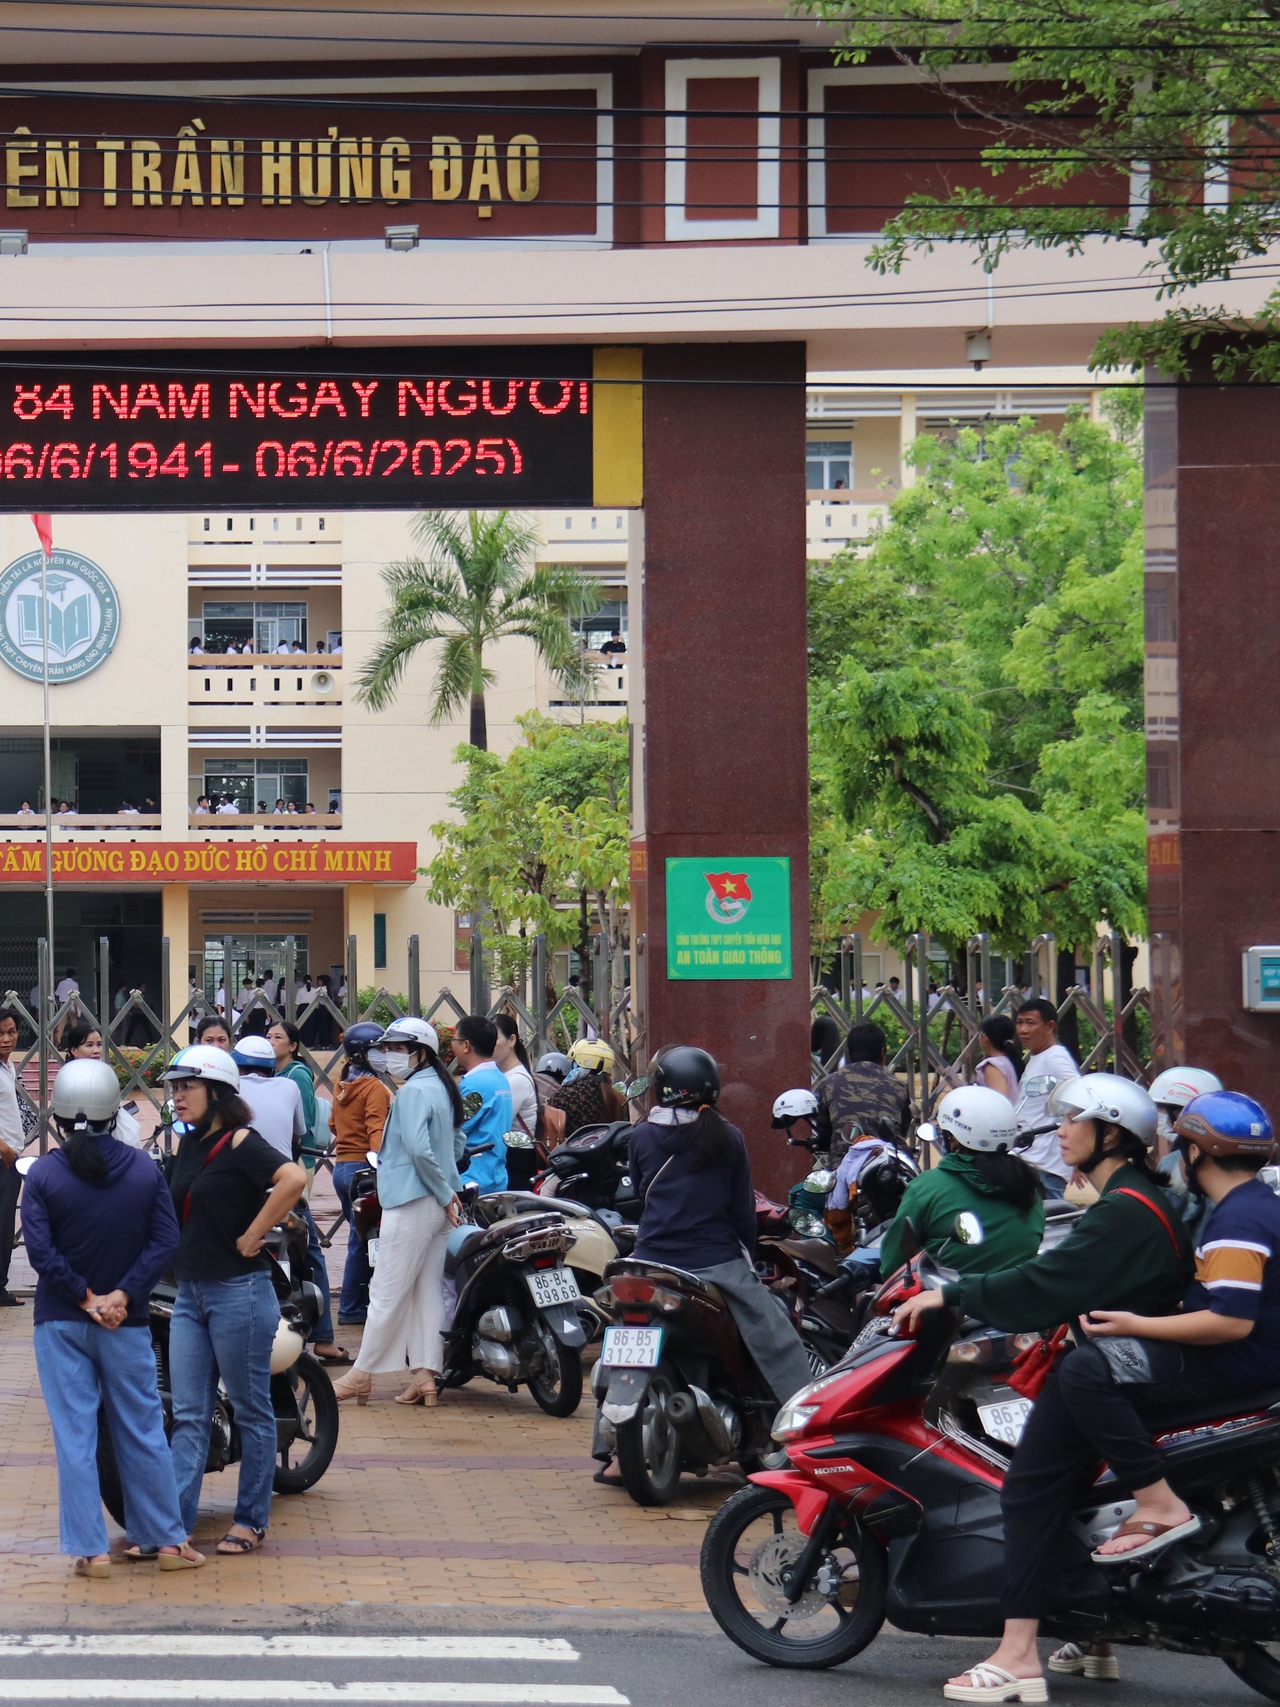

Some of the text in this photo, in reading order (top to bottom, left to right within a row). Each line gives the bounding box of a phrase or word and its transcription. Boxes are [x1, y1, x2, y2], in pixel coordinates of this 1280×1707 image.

[96, 118, 244, 208] TRẦN
[261, 126, 411, 207] HƯNG
[429, 132, 541, 219] ĐẠO
[12, 383, 74, 421] 84
[51, 847, 125, 873] GƯƠNG
[130, 850, 180, 877] ĐẠO
[183, 844, 231, 873] ĐỨC
[235, 843, 269, 872] HỒ
[272, 843, 319, 873] CHÍ
[323, 849, 392, 873] MINH
[677, 946, 782, 965] AN TOÀN GIAO THÔNG
[534, 1271, 568, 1290] 86-B4
[535, 1284, 578, 1305] 398.68
[613, 1330, 653, 1347] 86-B5
[605, 1347, 655, 1364] 312.21
[813, 1465, 855, 1475] HONDA
